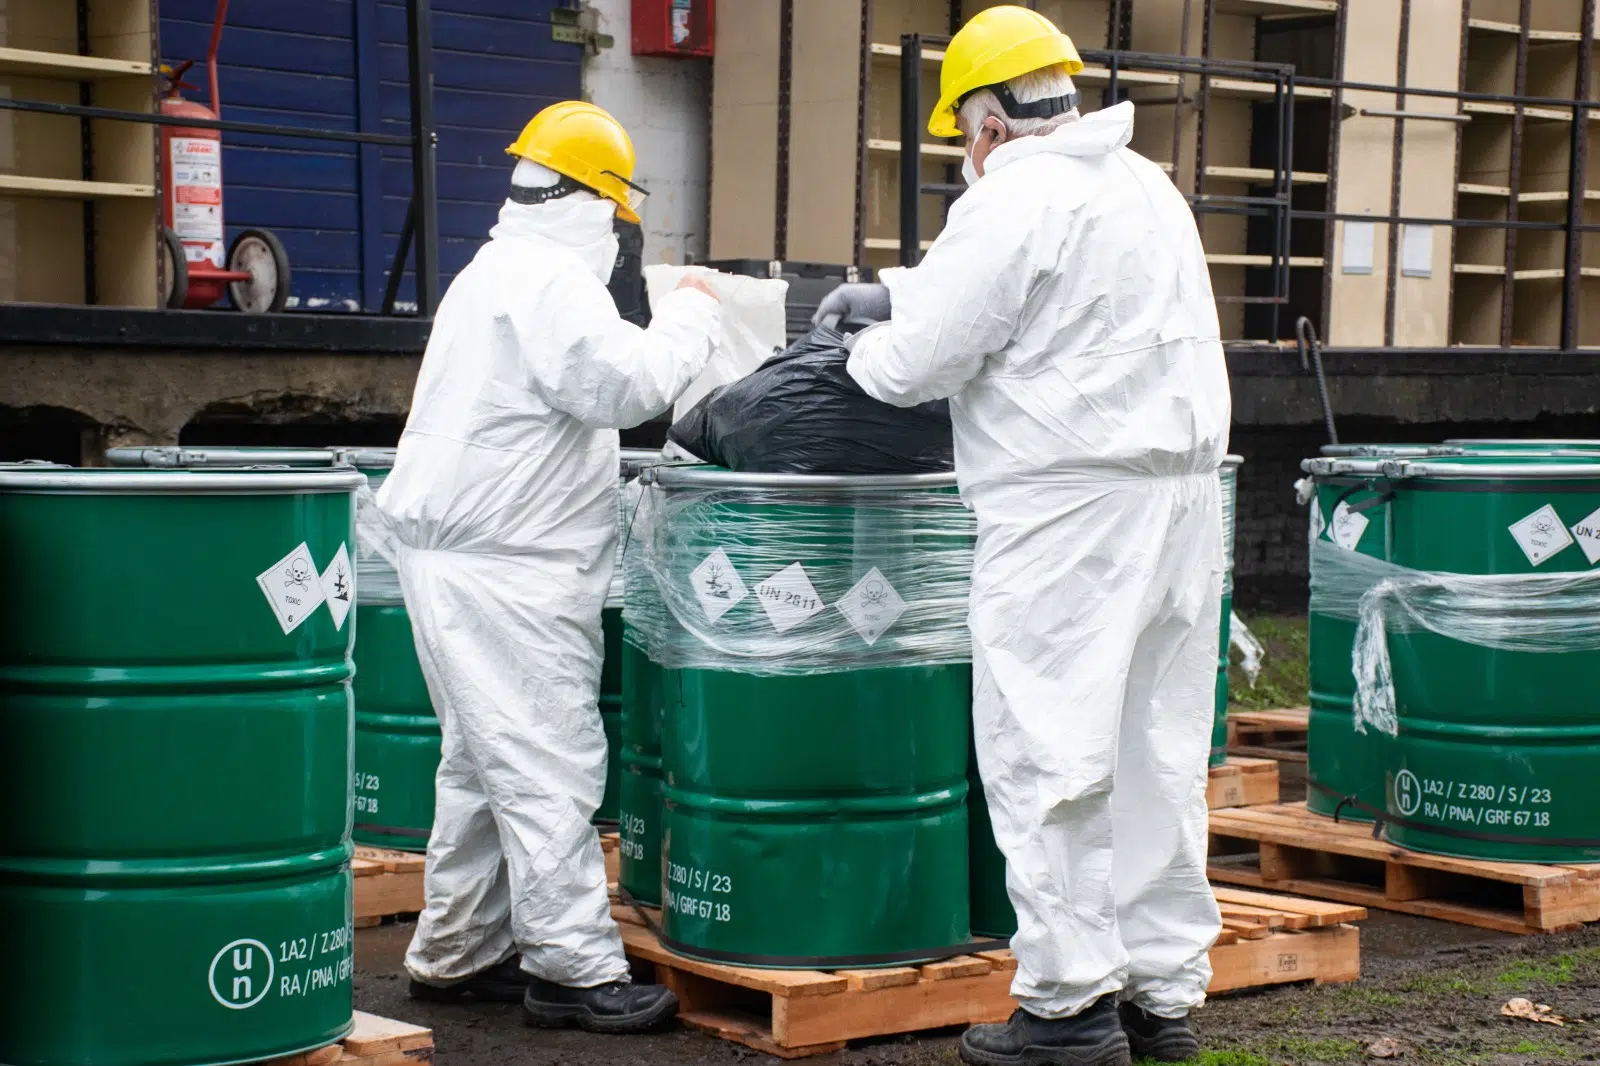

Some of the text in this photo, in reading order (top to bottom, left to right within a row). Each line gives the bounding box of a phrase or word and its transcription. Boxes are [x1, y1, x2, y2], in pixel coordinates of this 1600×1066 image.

[1576, 525, 1593, 538] UN
[285, 595, 302, 606] TOXIC
[760, 585, 816, 610] UN 2811
[287, 614, 293, 622] 6
[1423, 779, 1443, 796] 1A2
[1469, 784, 1495, 801] 280
[1531, 788, 1551, 803] 23
[1513, 810, 1530, 826] 67
[1533, 812, 1549, 826] 18
[712, 874, 732, 893] 23
[699, 900, 713, 919] 67
[715, 903, 731, 922] 18
[279, 938, 307, 962] 1A2
